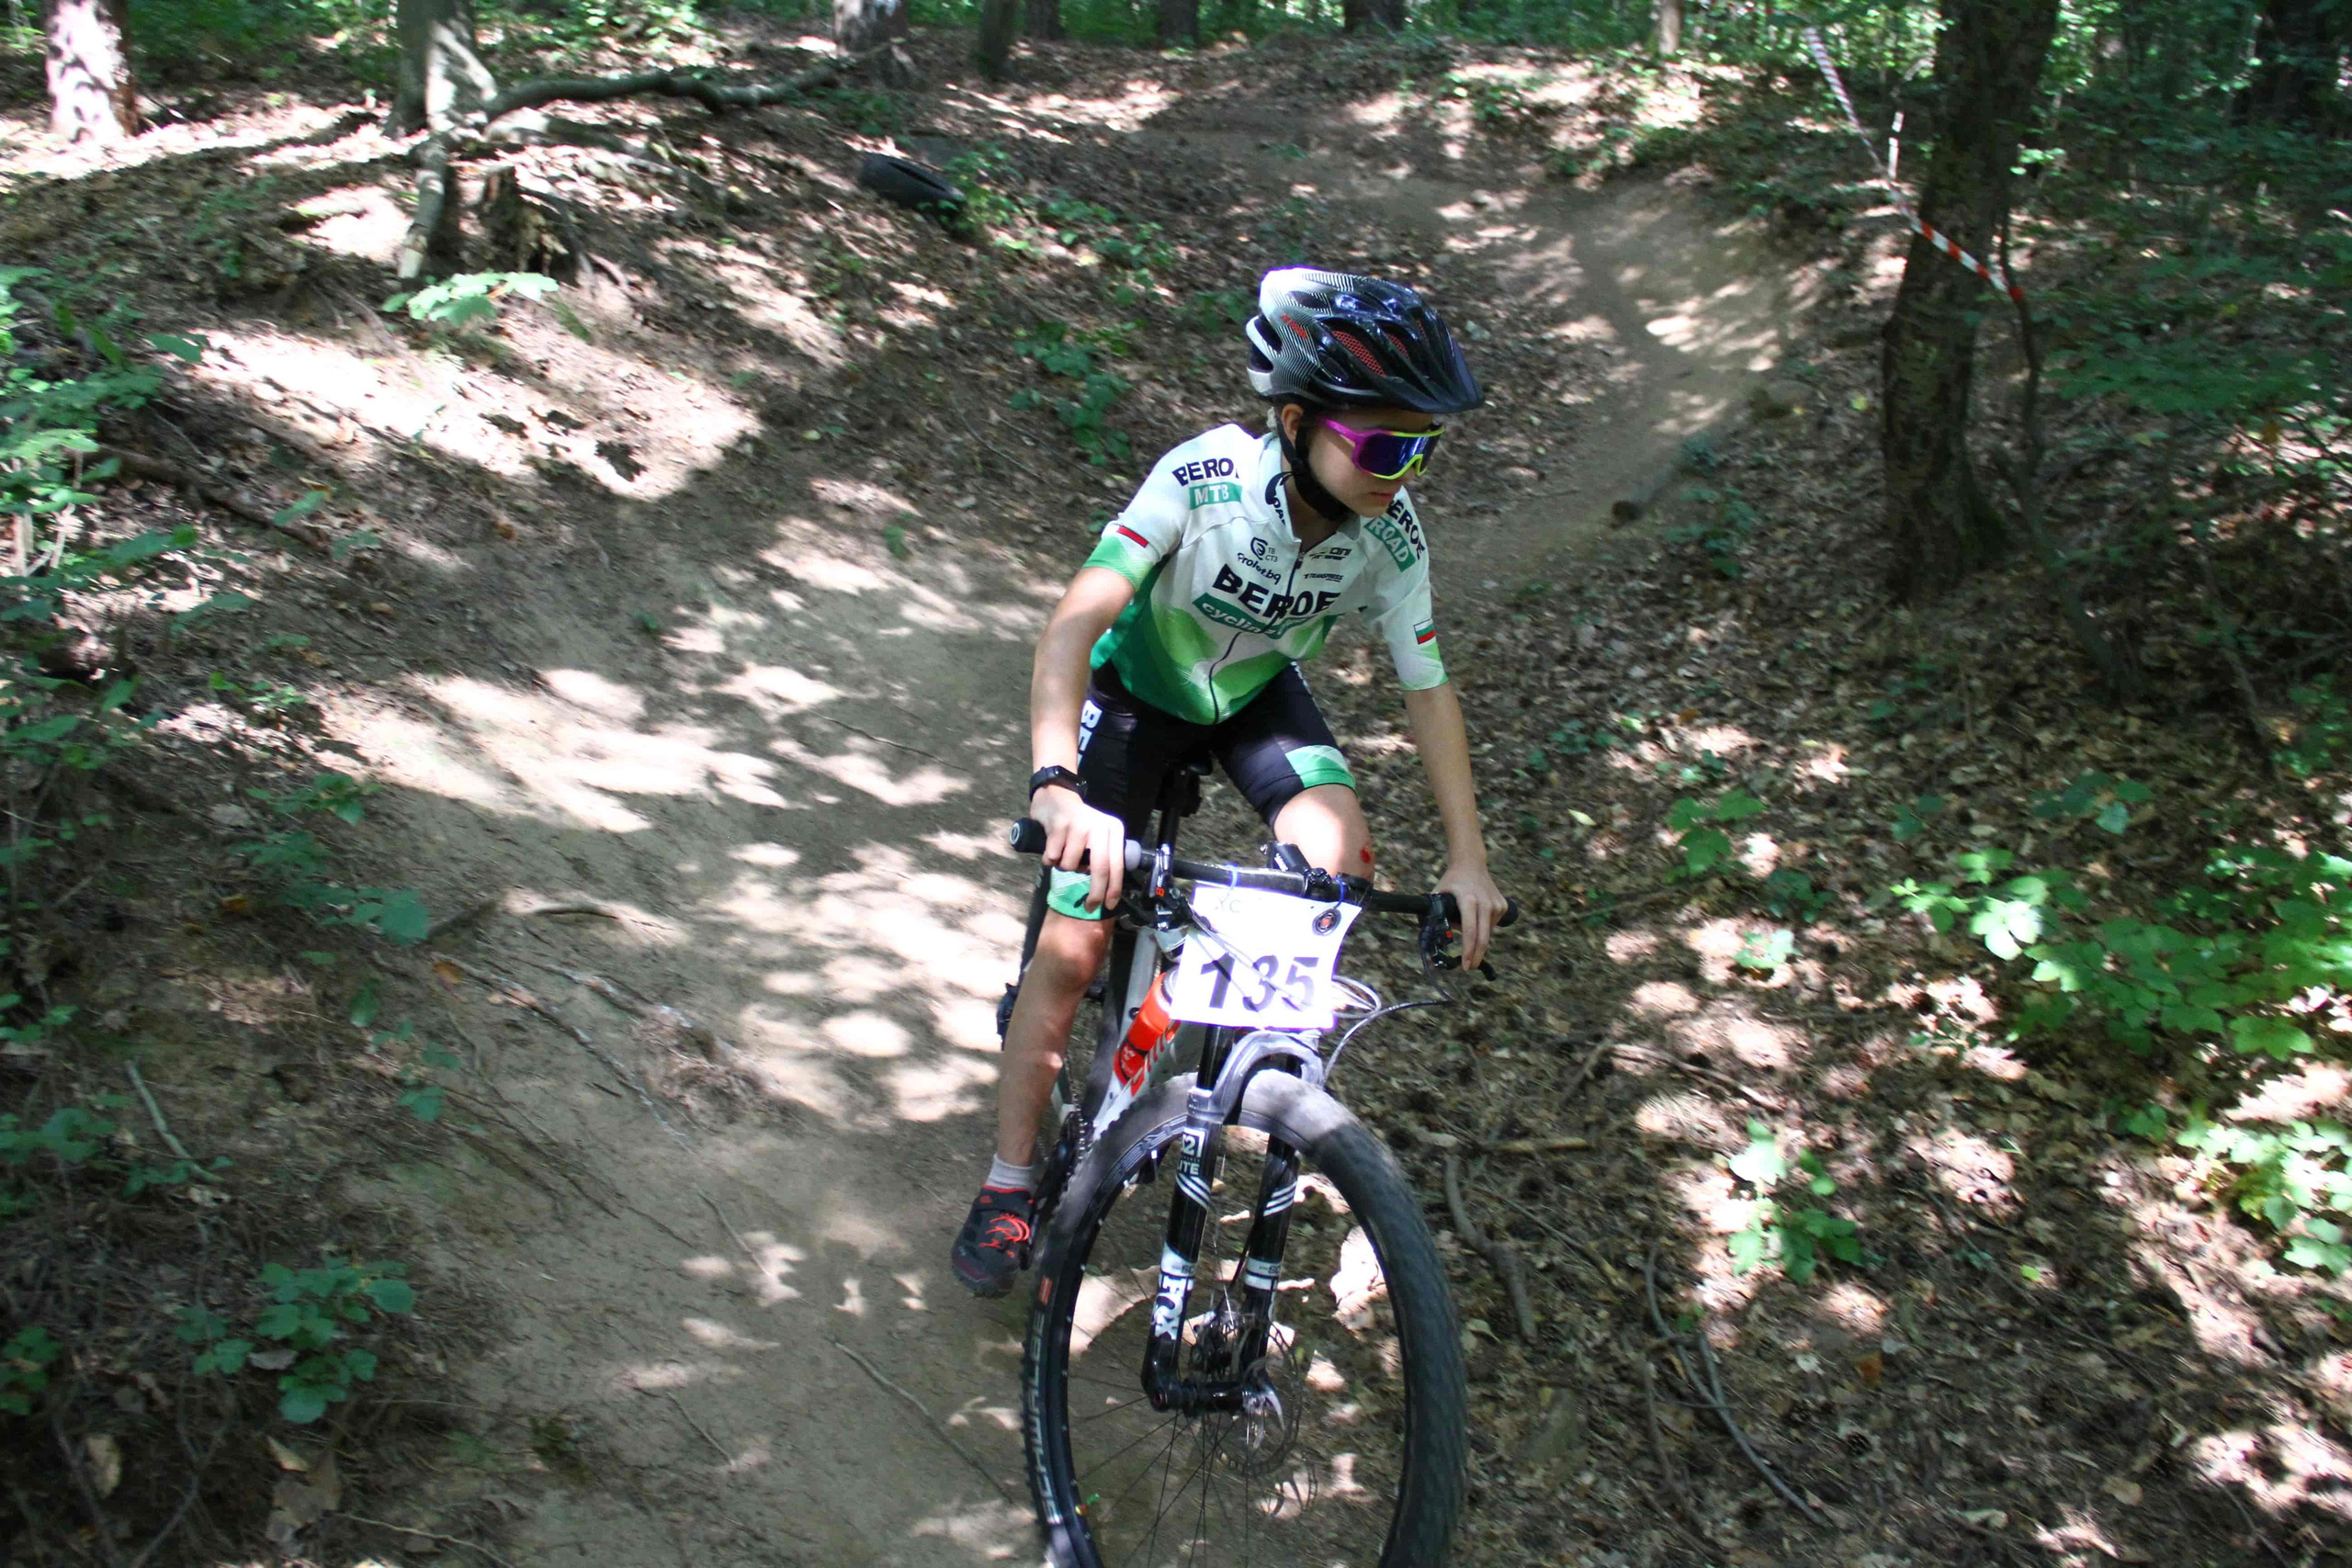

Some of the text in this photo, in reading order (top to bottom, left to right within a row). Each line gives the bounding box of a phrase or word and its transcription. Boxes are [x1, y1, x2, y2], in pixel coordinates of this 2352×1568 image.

[1171, 457, 1239, 487] BERO
[1194, 484, 1230, 506] MTB
[1368, 517, 1409, 562] ROAD
[1212, 563, 1341, 620] BEROE
[1200, 952, 1319, 1012] 135
[1153, 1275, 1187, 1340] FOX
[1027, 1311, 1063, 1525] SCHWALBE
